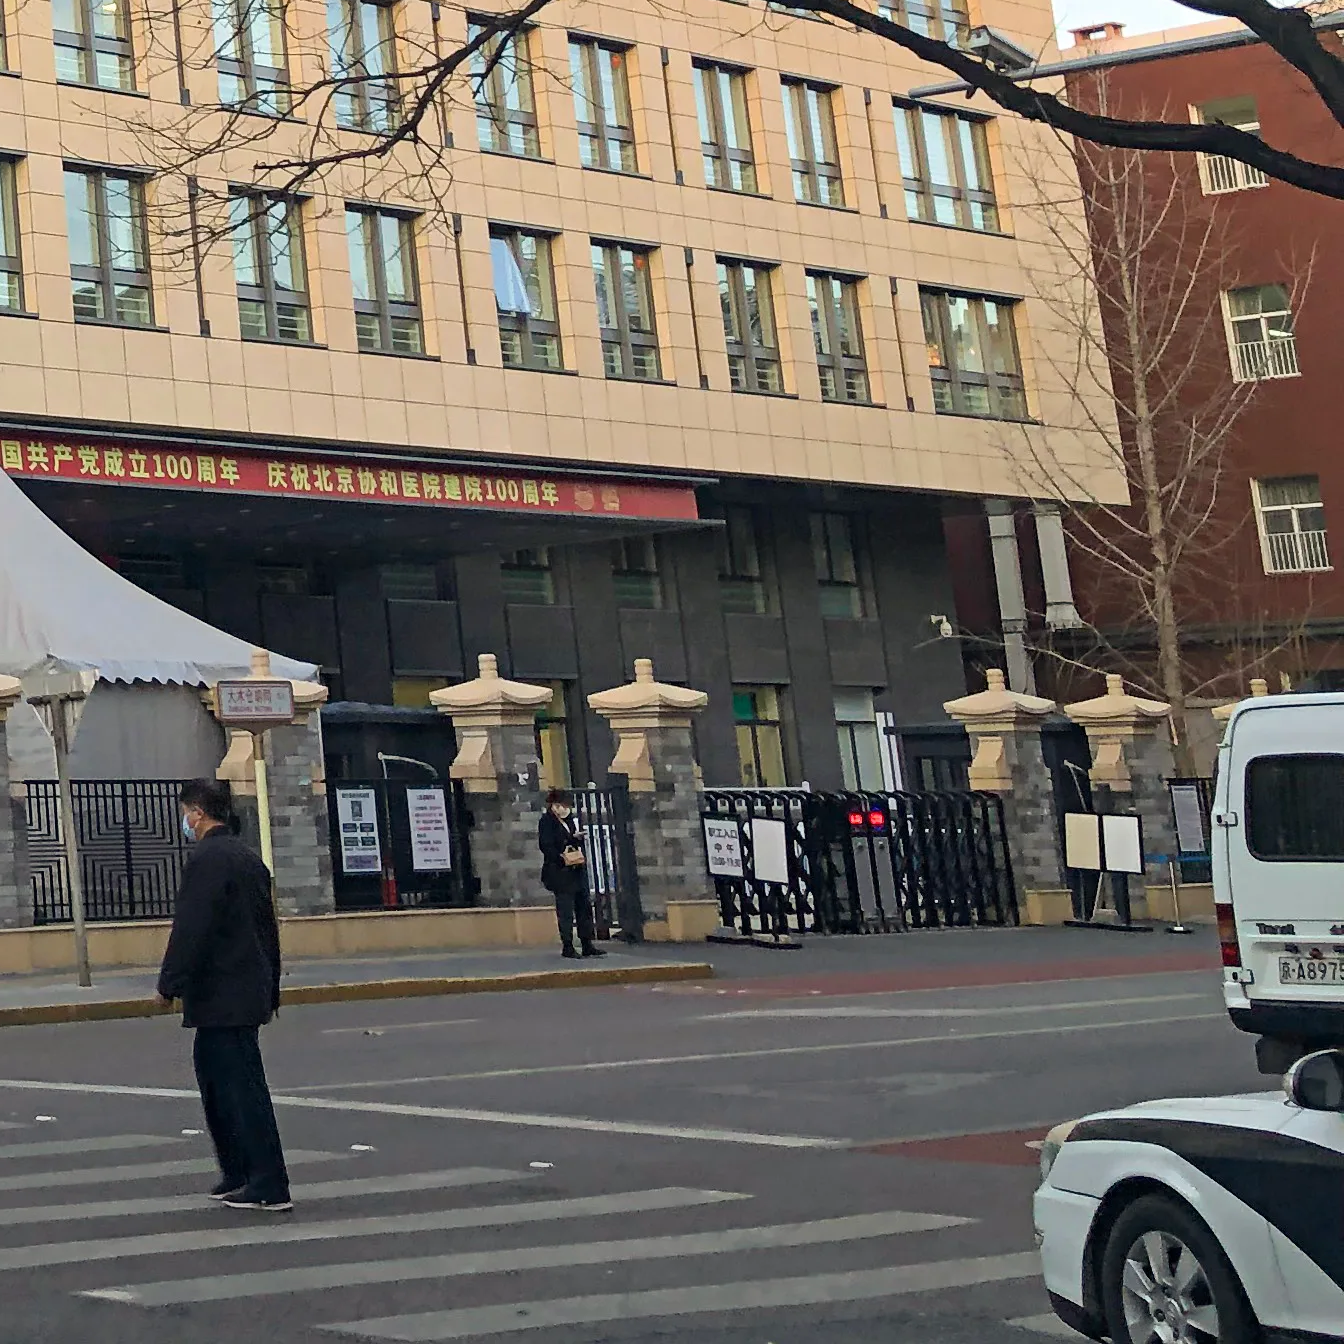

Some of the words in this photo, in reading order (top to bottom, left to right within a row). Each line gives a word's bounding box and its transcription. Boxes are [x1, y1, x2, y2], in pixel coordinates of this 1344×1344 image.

[267, 460, 560, 506] 庆祝北京协和医院建院100周年
